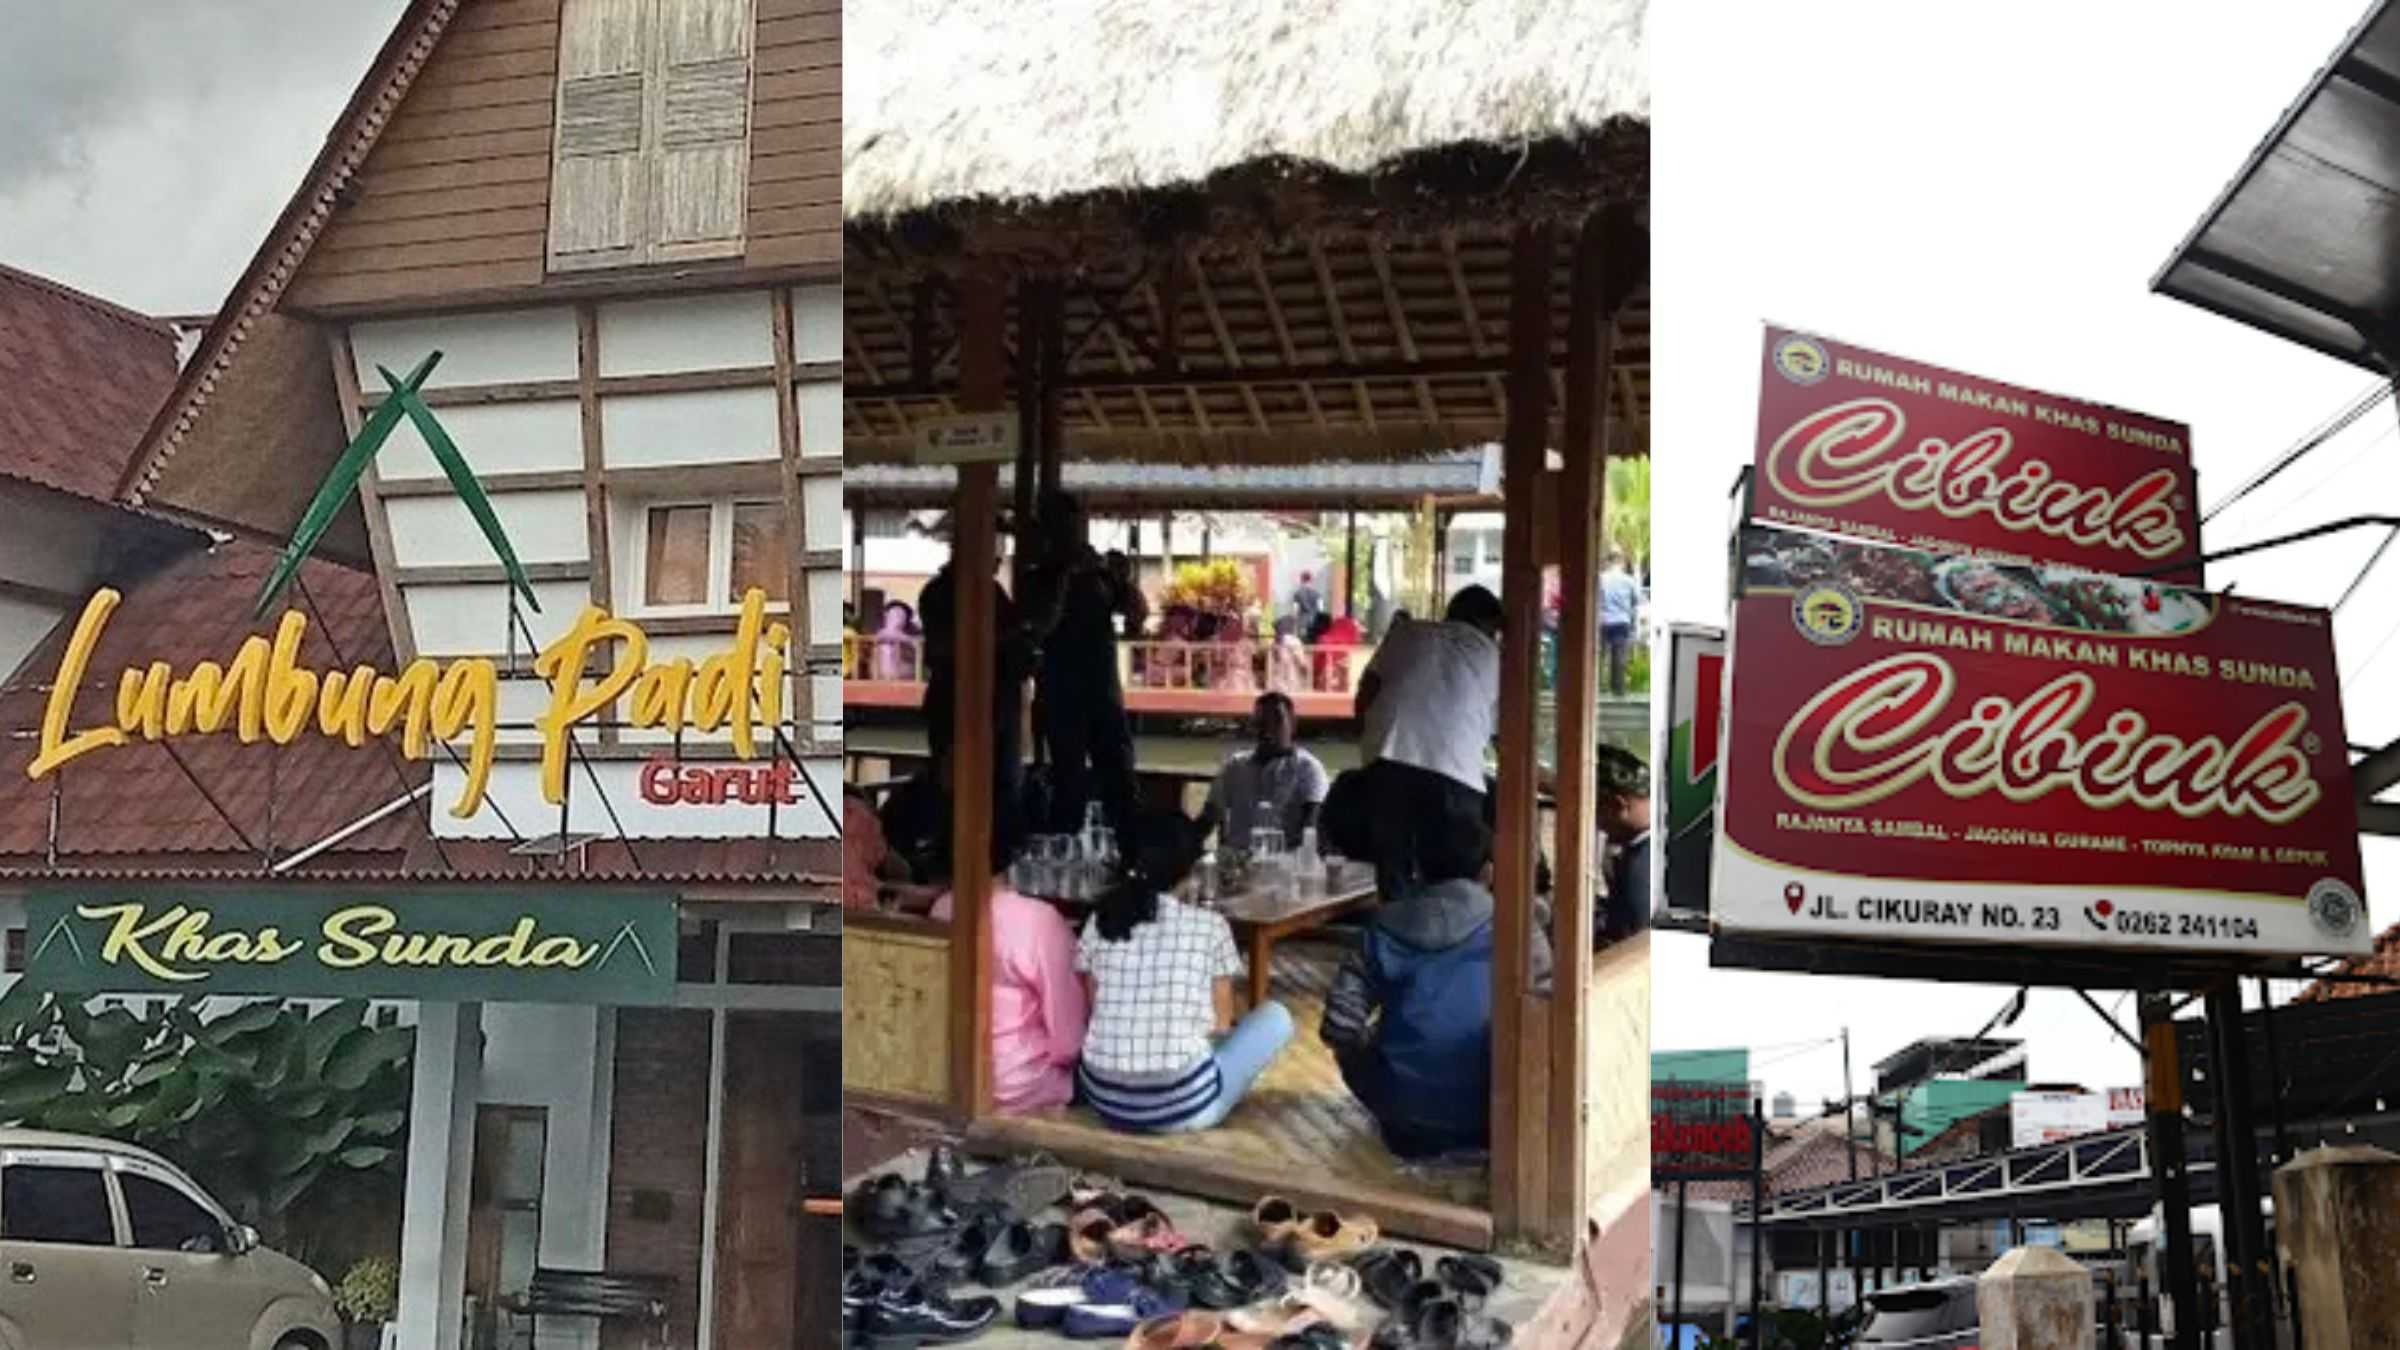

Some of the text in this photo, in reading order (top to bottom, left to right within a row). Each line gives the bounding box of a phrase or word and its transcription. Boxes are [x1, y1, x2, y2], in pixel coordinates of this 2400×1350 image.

[1836, 358, 1931, 395] RUMAH
[1937, 381, 2028, 418] MAKAN
[2035, 404, 2100, 435] KHAS
[2106, 421, 2183, 454] SUNDA
[1765, 398, 2186, 559] Cibiuk
[1872, 615, 2317, 690] RUMAH MAKAN KHAS SUNDA
[27, 587, 791, 818] Lumbung Padi
[1773, 651, 2322, 823] Cibiuk
[640, 752, 799, 806] Garut
[76, 902, 602, 982] Khas Sunda
[1809, 894, 2061, 931] JL. CIKURAY NO. 23
[2116, 910, 2172, 935] 0262
